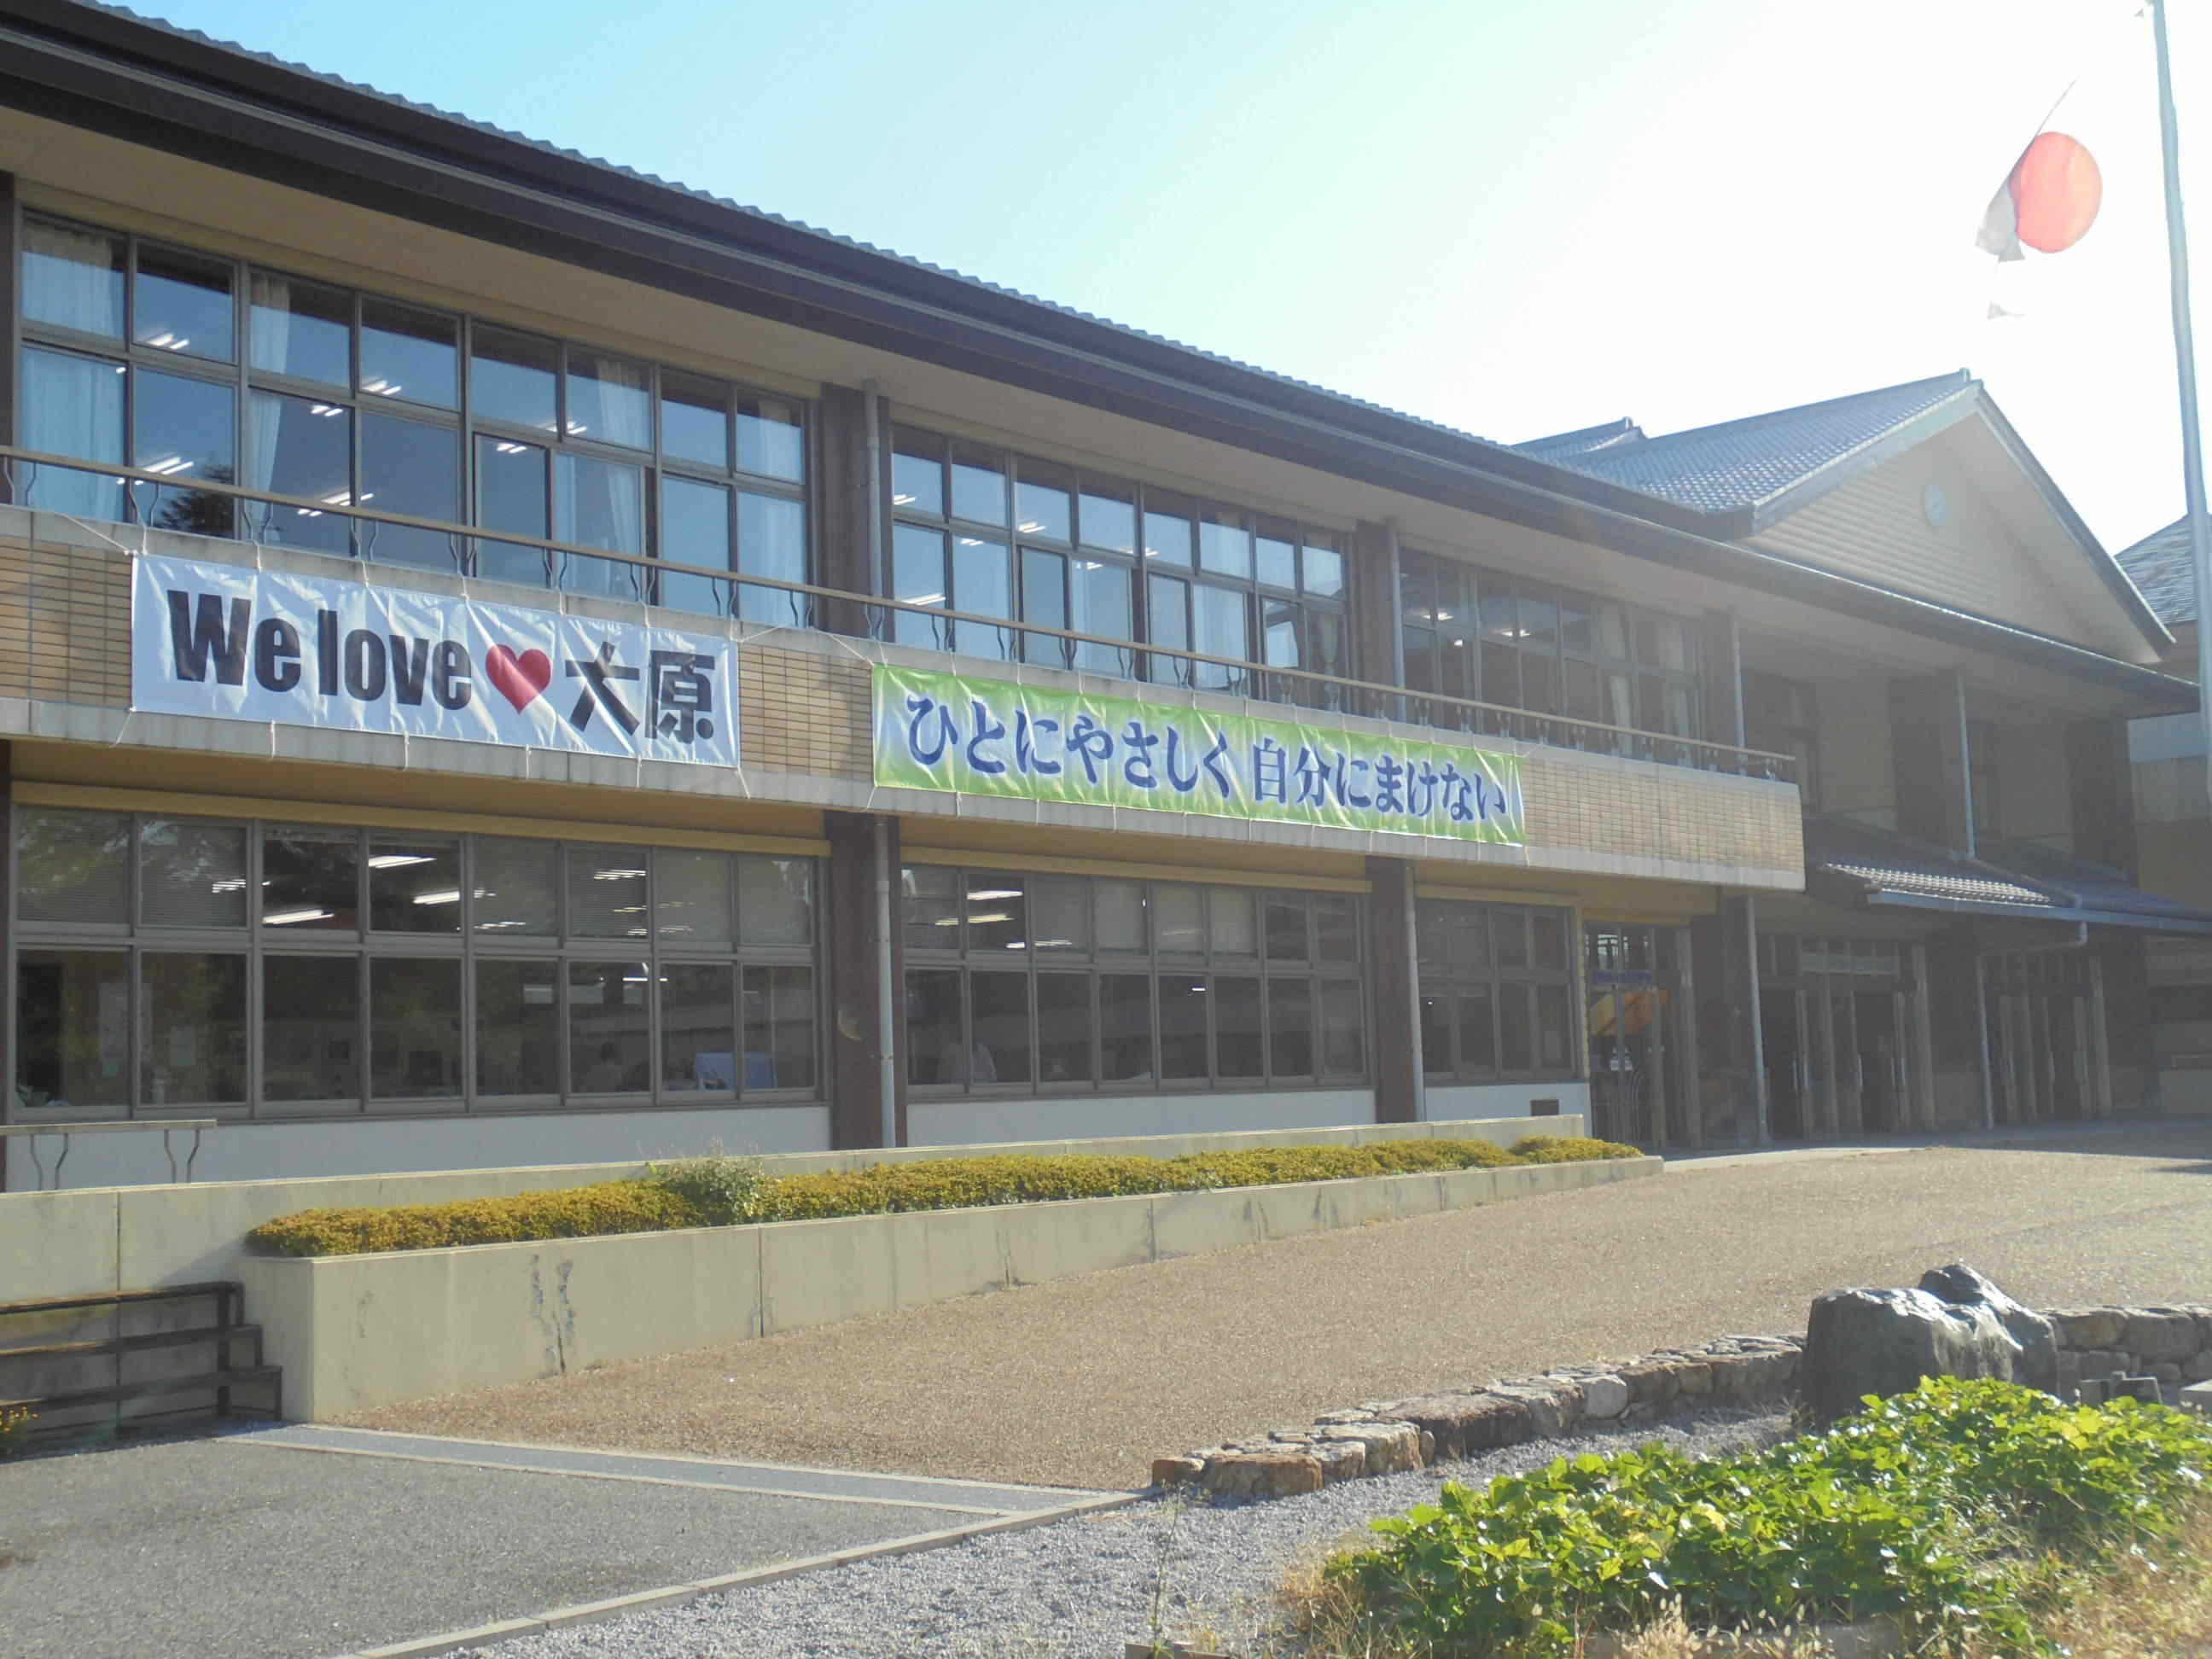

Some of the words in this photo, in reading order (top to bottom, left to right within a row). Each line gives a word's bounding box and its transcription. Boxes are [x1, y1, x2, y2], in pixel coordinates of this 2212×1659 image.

[166, 589, 302, 693] We
[317, 608, 473, 712] love
[564, 642, 716, 743] 大原
[905, 694, 1231, 798] ひとにやさしく
[1253, 736, 1507, 821] 自分にまけない
